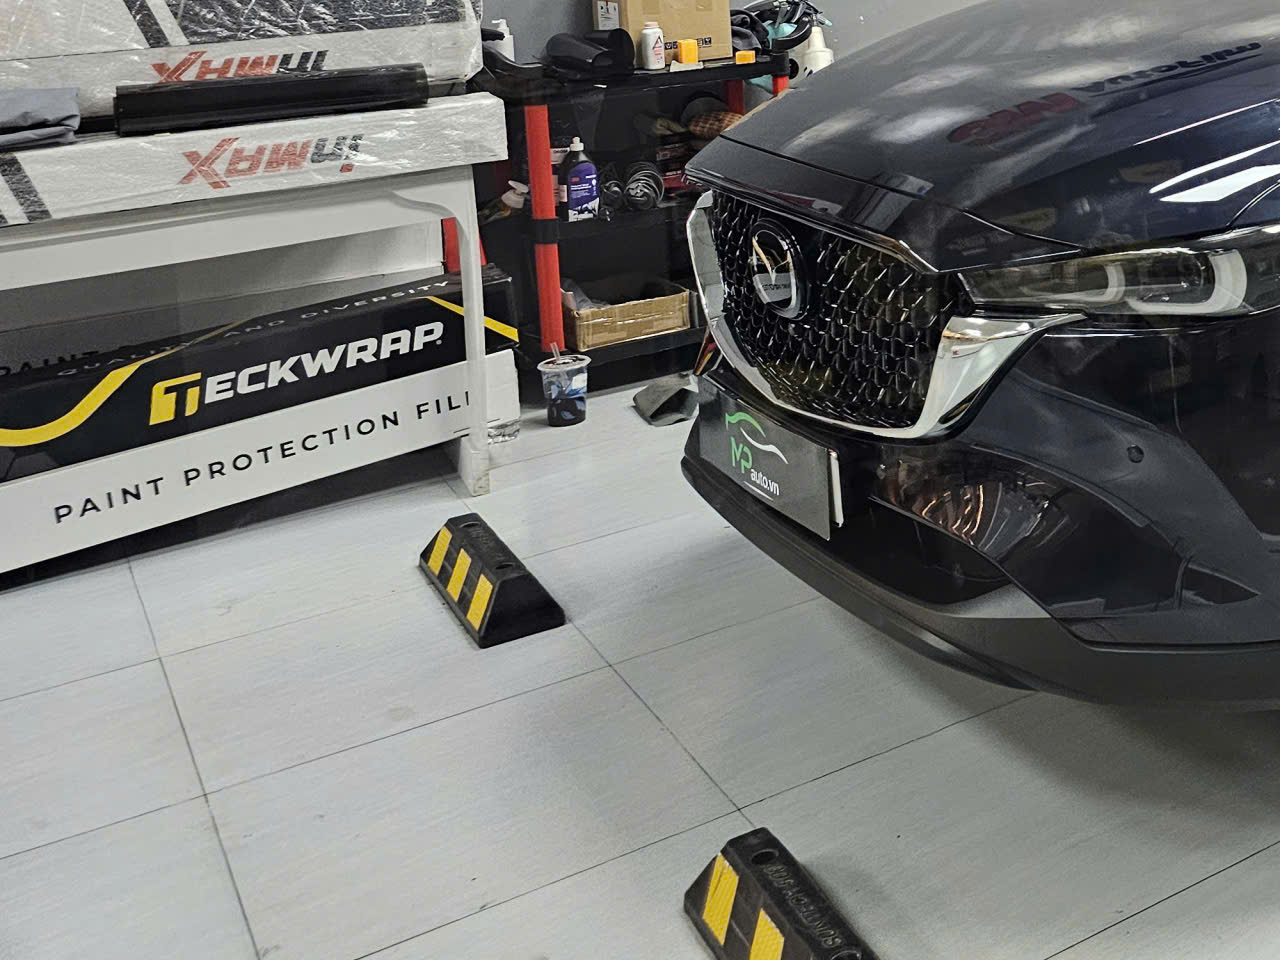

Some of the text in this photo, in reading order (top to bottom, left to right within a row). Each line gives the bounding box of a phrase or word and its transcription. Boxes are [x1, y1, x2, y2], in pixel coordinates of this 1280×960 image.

[223, 319, 286, 338] AND
[300, 280, 449, 319] DIVERSITY
[148, 321, 444, 426] TECKWRAP
[54, 390, 470, 524] PAINT PROTECTION FIL
[730, 436, 753, 474] MP
[750, 468, 780, 496] auto.vn
